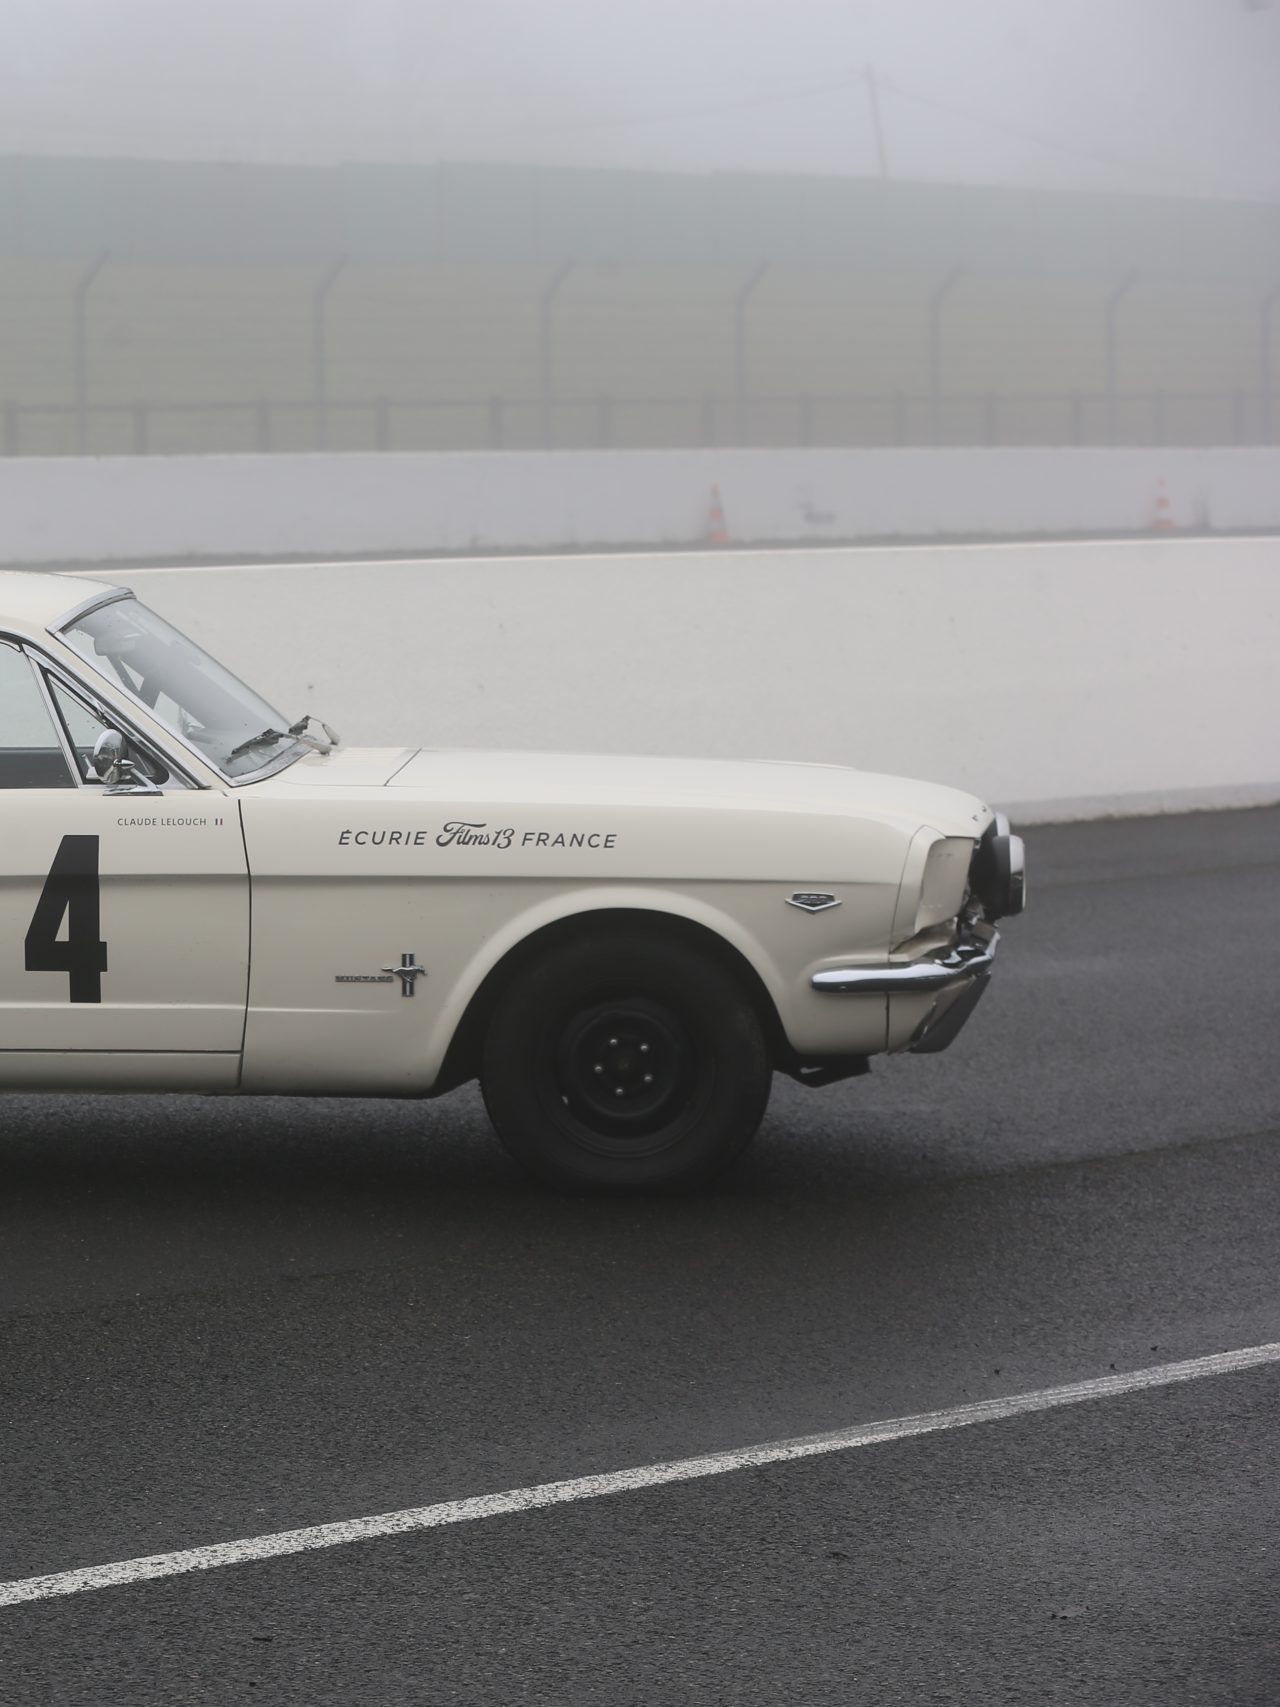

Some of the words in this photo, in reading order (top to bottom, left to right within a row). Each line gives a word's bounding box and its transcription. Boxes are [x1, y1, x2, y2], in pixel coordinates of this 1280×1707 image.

[117, 817, 157, 826] CLAUDE
[161, 817, 207, 826] LELOUCH
[338, 828, 428, 846] ÉCURIE
[521, 831, 618, 849] FRANCE
